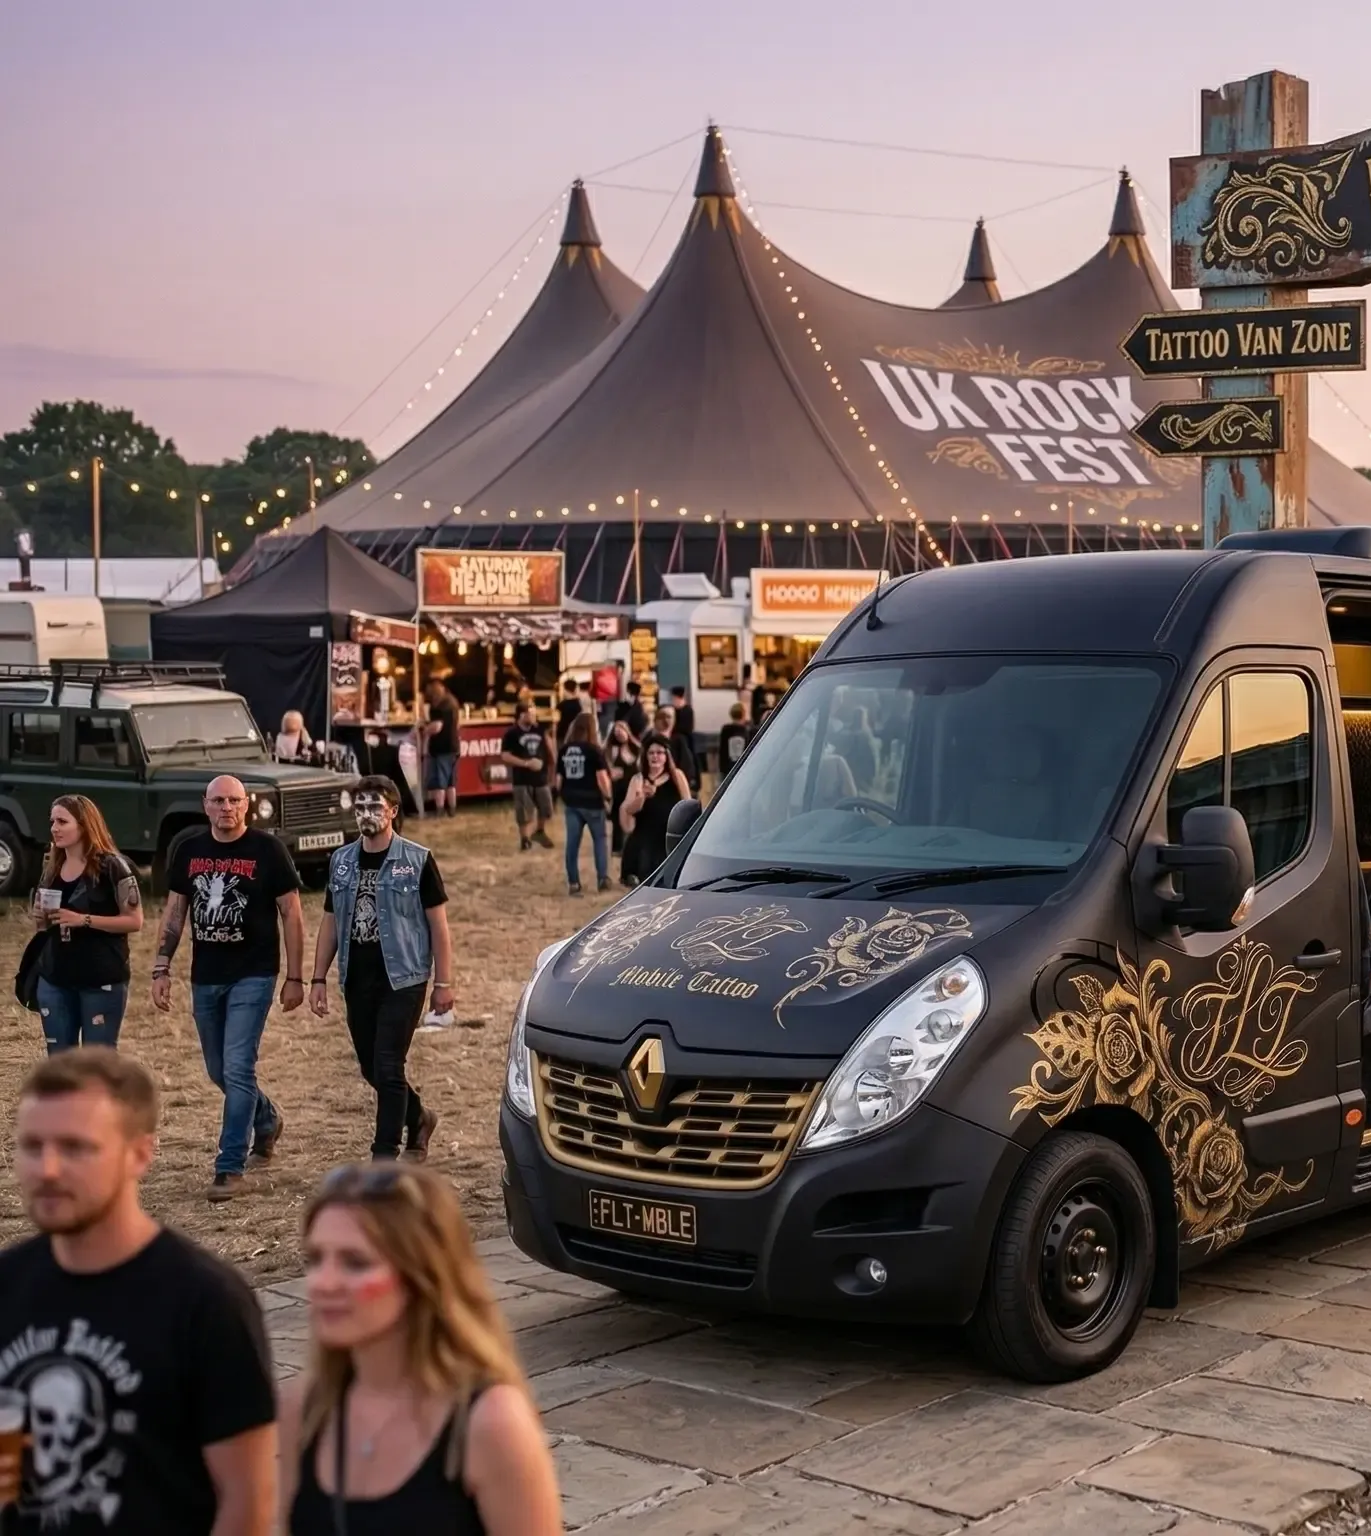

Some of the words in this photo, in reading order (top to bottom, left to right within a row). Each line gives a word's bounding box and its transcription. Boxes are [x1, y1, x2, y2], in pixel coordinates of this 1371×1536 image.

[860, 358, 990, 432] UK
[969, 375, 1149, 435] ROCK
[985, 432, 1152, 485] FEST
[460, 556, 529, 573] SATURDAY
[608, 965, 683, 990] Mobile
[687, 971, 760, 999] Tattoo
[600, 1198, 692, 1239] FLT-MBLE
